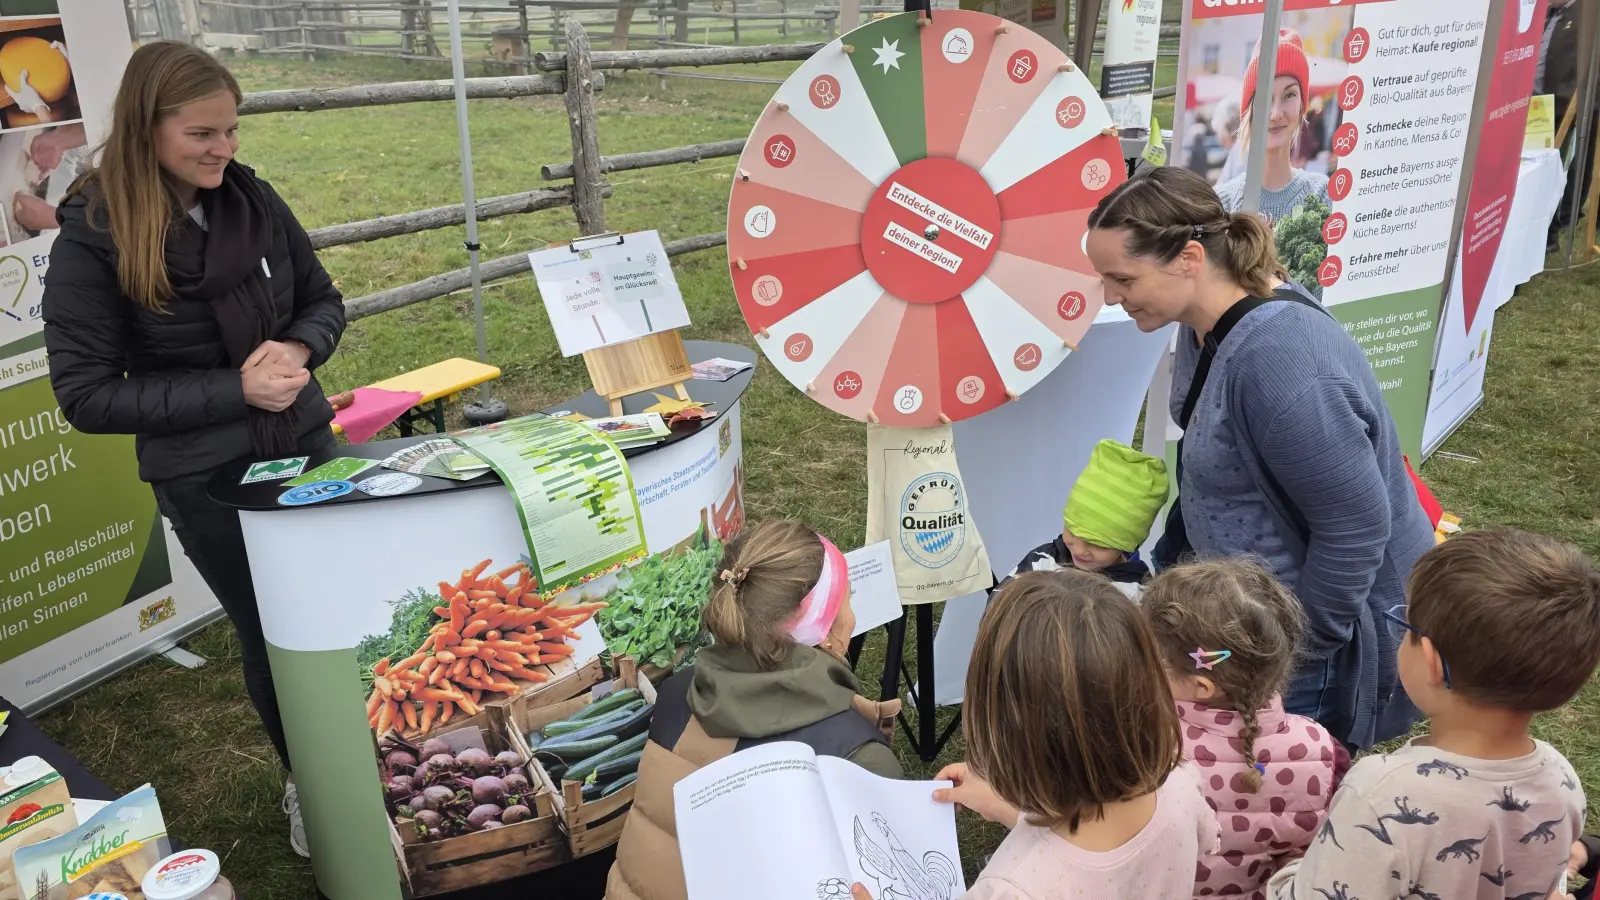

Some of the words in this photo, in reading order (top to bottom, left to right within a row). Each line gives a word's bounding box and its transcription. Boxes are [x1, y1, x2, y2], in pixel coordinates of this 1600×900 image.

[1136, 14, 1157, 26] regional
[1378, 29, 1394, 40] Gut
[1396, 26, 1410, 38] für
[1411, 25, 1432, 37] dich,
[1434, 23, 1449, 37] gut
[1451, 21, 1464, 33] für
[1465, 20, 1484, 31] deine
[1376, 45, 1410, 58] Heimat:
[1412, 41, 1440, 54] Kaufe
[1441, 36, 1478, 52] regional!
[1372, 74, 1412, 88] Vertraue
[1414, 72, 1430, 83] auf
[1431, 67, 1467, 85] geprüfte
[1370, 88, 1427, 107] (Bio)-Qualität
[1430, 88, 1445, 98] aus
[1366, 118, 1412, 134] Schmecke
[1414, 114, 1439, 128] deine
[1441, 112, 1467, 128] Region
[1364, 141, 1372, 151] in
[1374, 137, 1409, 150] Kantine,
[1412, 133, 1440, 144] Mensa
[1442, 130, 1448, 139] &
[1450, 128, 1461, 138] Co!
[1360, 165, 1399, 179] Besuche
[1400, 161, 1434, 174] Bayerns
[1436, 156, 1459, 168] ausge-
[1358, 181, 1400, 196] zeichnete
[1401, 172, 1453, 189] GenussOrte!
[891, 187, 936, 218] Entdecke
[937, 213, 953, 226] die
[954, 220, 988, 245] Vielfalt
[1355, 208, 1393, 223] Genieße
[1394, 206, 1408, 217] die
[1352, 227, 1379, 240] Küche
[1380, 220, 1417, 236] Bayerns!
[888, 228, 920, 249] deiner
[920, 244, 958, 269] Region!
[1350, 251, 1383, 266] Erfahre
[1384, 247, 1408, 260] mehr
[1410, 244, 1430, 255] über
[613, 270, 655, 282] Hauptgewinn
[1347, 263, 1400, 282] GenussErbe!
[565, 293, 583, 303] Jede
[583, 286, 601, 296] volle
[625, 279, 658, 290] Glücksrad!
[573, 299, 601, 312] Stunde:
[1356, 316, 1383, 331] stellen
[1385, 314, 1398, 324] dir
[1399, 313, 1414, 322] vor,
[1416, 309, 1428, 318] wo
[1357, 333, 1372, 344] wie
[1373, 329, 1384, 341] du
[1386, 327, 1400, 338] die
[1402, 321, 1432, 335] Qualität
[1386, 338, 1418, 353] Bayerns
[1375, 355, 1406, 368] kannst.
[1379, 378, 1402, 391] Wahl!
[904, 440, 947, 458] Regional
[245, 472, 299, 483] Naturland
[670, 478, 691, 492] Forsten
[902, 512, 964, 530] Qualität
[10, 557, 41, 583] und
[45, 518, 134, 567] Realschüler
[38, 542, 135, 597] Lebensmittel
[916, 579, 954, 591] gq-bayern.de
[34, 591, 88, 625] Sinnen
[25, 663, 67, 688] Regierung
[68, 655, 83, 668] von
[84, 630, 133, 659] Unterfranken
[61, 829, 129, 884] Knabber
